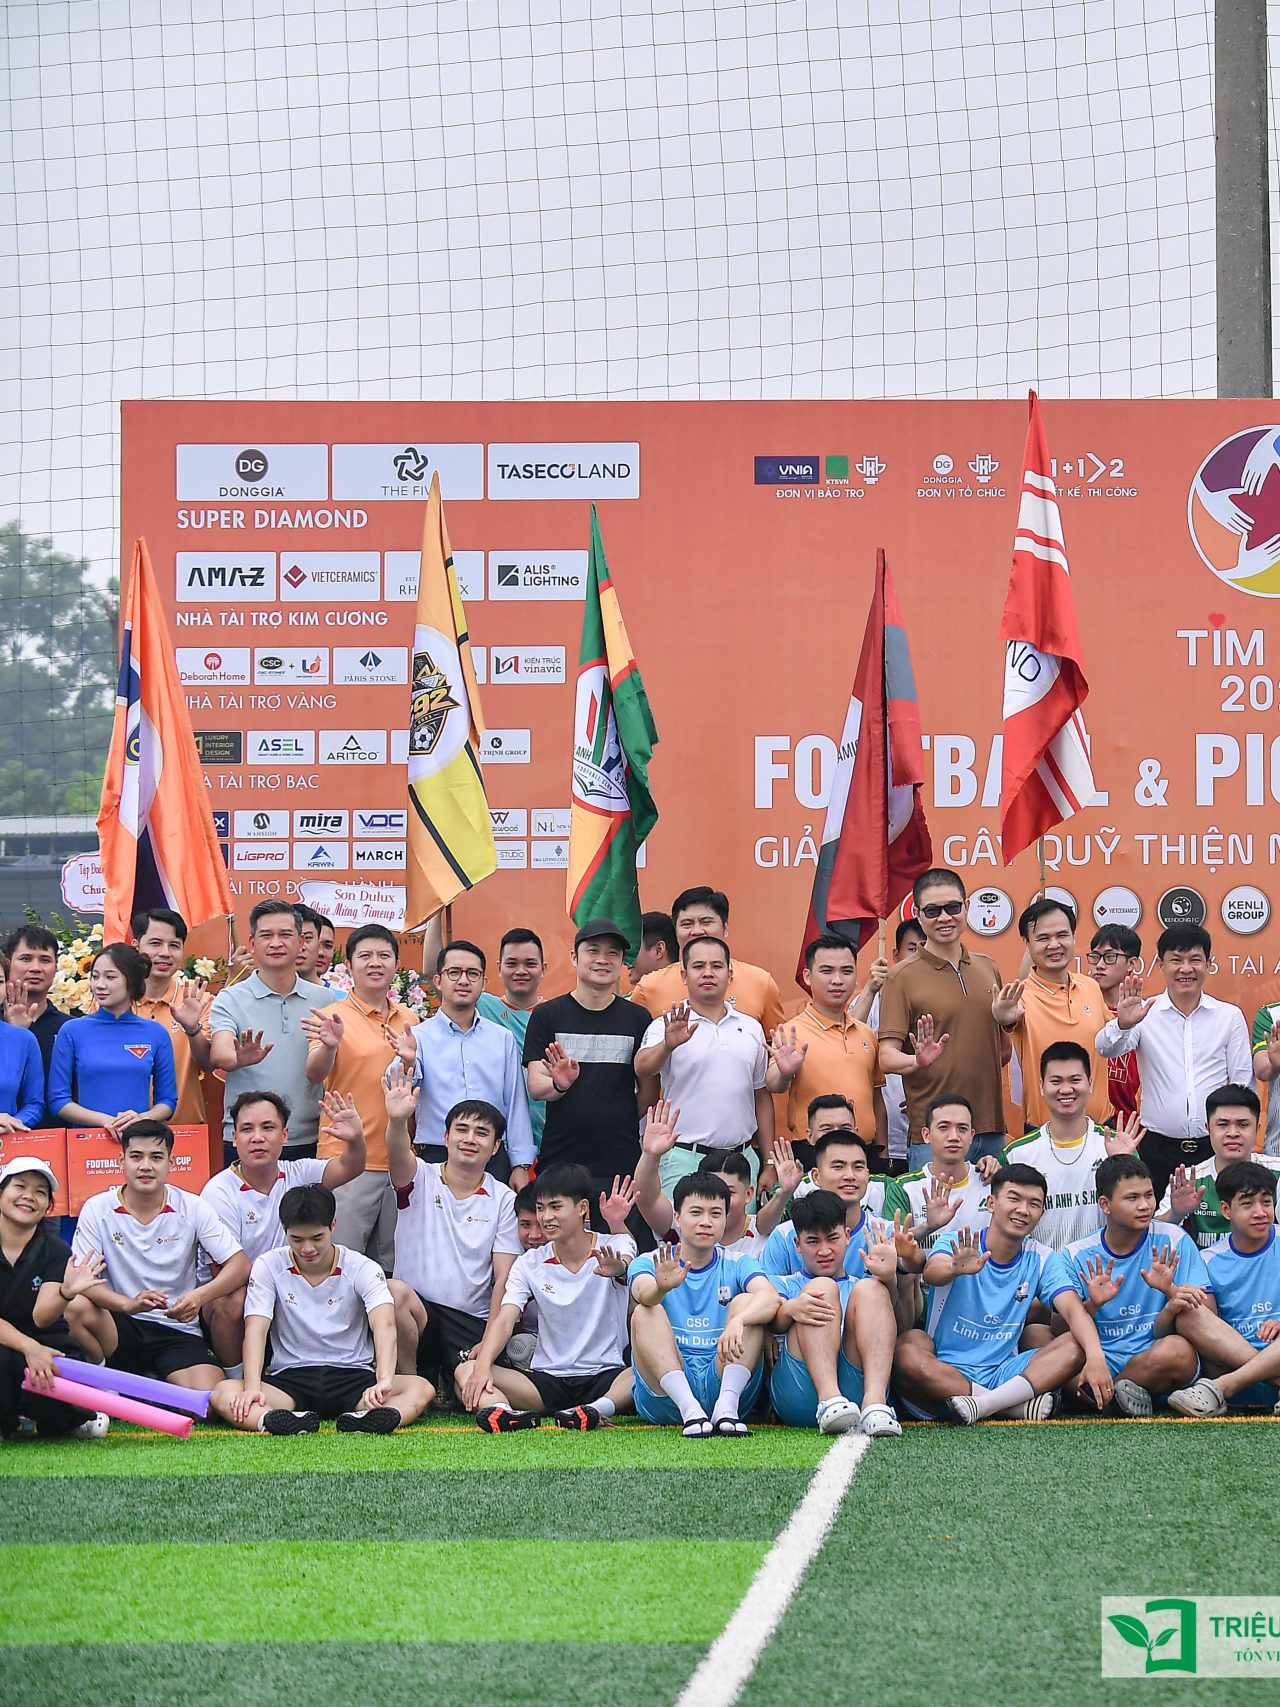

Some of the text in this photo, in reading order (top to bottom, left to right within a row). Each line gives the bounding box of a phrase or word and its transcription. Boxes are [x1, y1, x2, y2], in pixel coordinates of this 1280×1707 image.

[238, 459, 265, 473] DG
[935, 460, 951, 469] DG
[923, 476, 963, 484] DONGGIA
[218, 486, 284, 498] DONGGIA
[381, 485, 409, 496] THE
[775, 486, 865, 500] ĐƠN VỊ BẢO TRỢ
[916, 485, 1006, 500] ĐƠN VỊ TỔ CHỨC
[1087, 488, 1103, 497] THI
[1105, 486, 1138, 497] CÔNG
[176, 508, 369, 530] SUPER DIAMOND
[311, 571, 376, 584] VIETCERAMICS
[523, 576, 580, 587] LIGHTING
[175, 608, 389, 630] NHÀ TÀI TRỢ KIM CƯƠNG
[524, 664, 562, 674] vinavic
[180, 671, 246, 682] Deborah Home
[369, 675, 397, 683] STONE
[218, 691, 244, 710] TÀI
[249, 693, 282, 712] TRỢ
[286, 691, 337, 710] VÀNG
[258, 738, 304, 752] ASEL
[326, 751, 378, 761] ARITCO
[218, 771, 244, 789] TÀI
[249, 773, 282, 792] TRỢ
[286, 773, 320, 792] BẠC
[1133, 757, 1170, 807] &
[299, 812, 343, 828] mira
[356, 850, 404, 862] MARCH
[1035, 826, 1122, 873] QUỸ
[1133, 824, 1255, 875] THIỆN
[248, 877, 281, 897] TRỢ
[1227, 900, 1264, 910] KENLI
[1227, 910, 1265, 921] GROUP
[1227, 955, 1265, 978] TẠI
[176, 1156, 192, 1165] CUP
[1055, 1193, 1073, 1209] ANH
[1119, 1303, 1142, 1317] CSC
[1250, 1301, 1273, 1314] CSC
[686, 1317, 711, 1328] CSC
[952, 1320, 980, 1341] Linh
